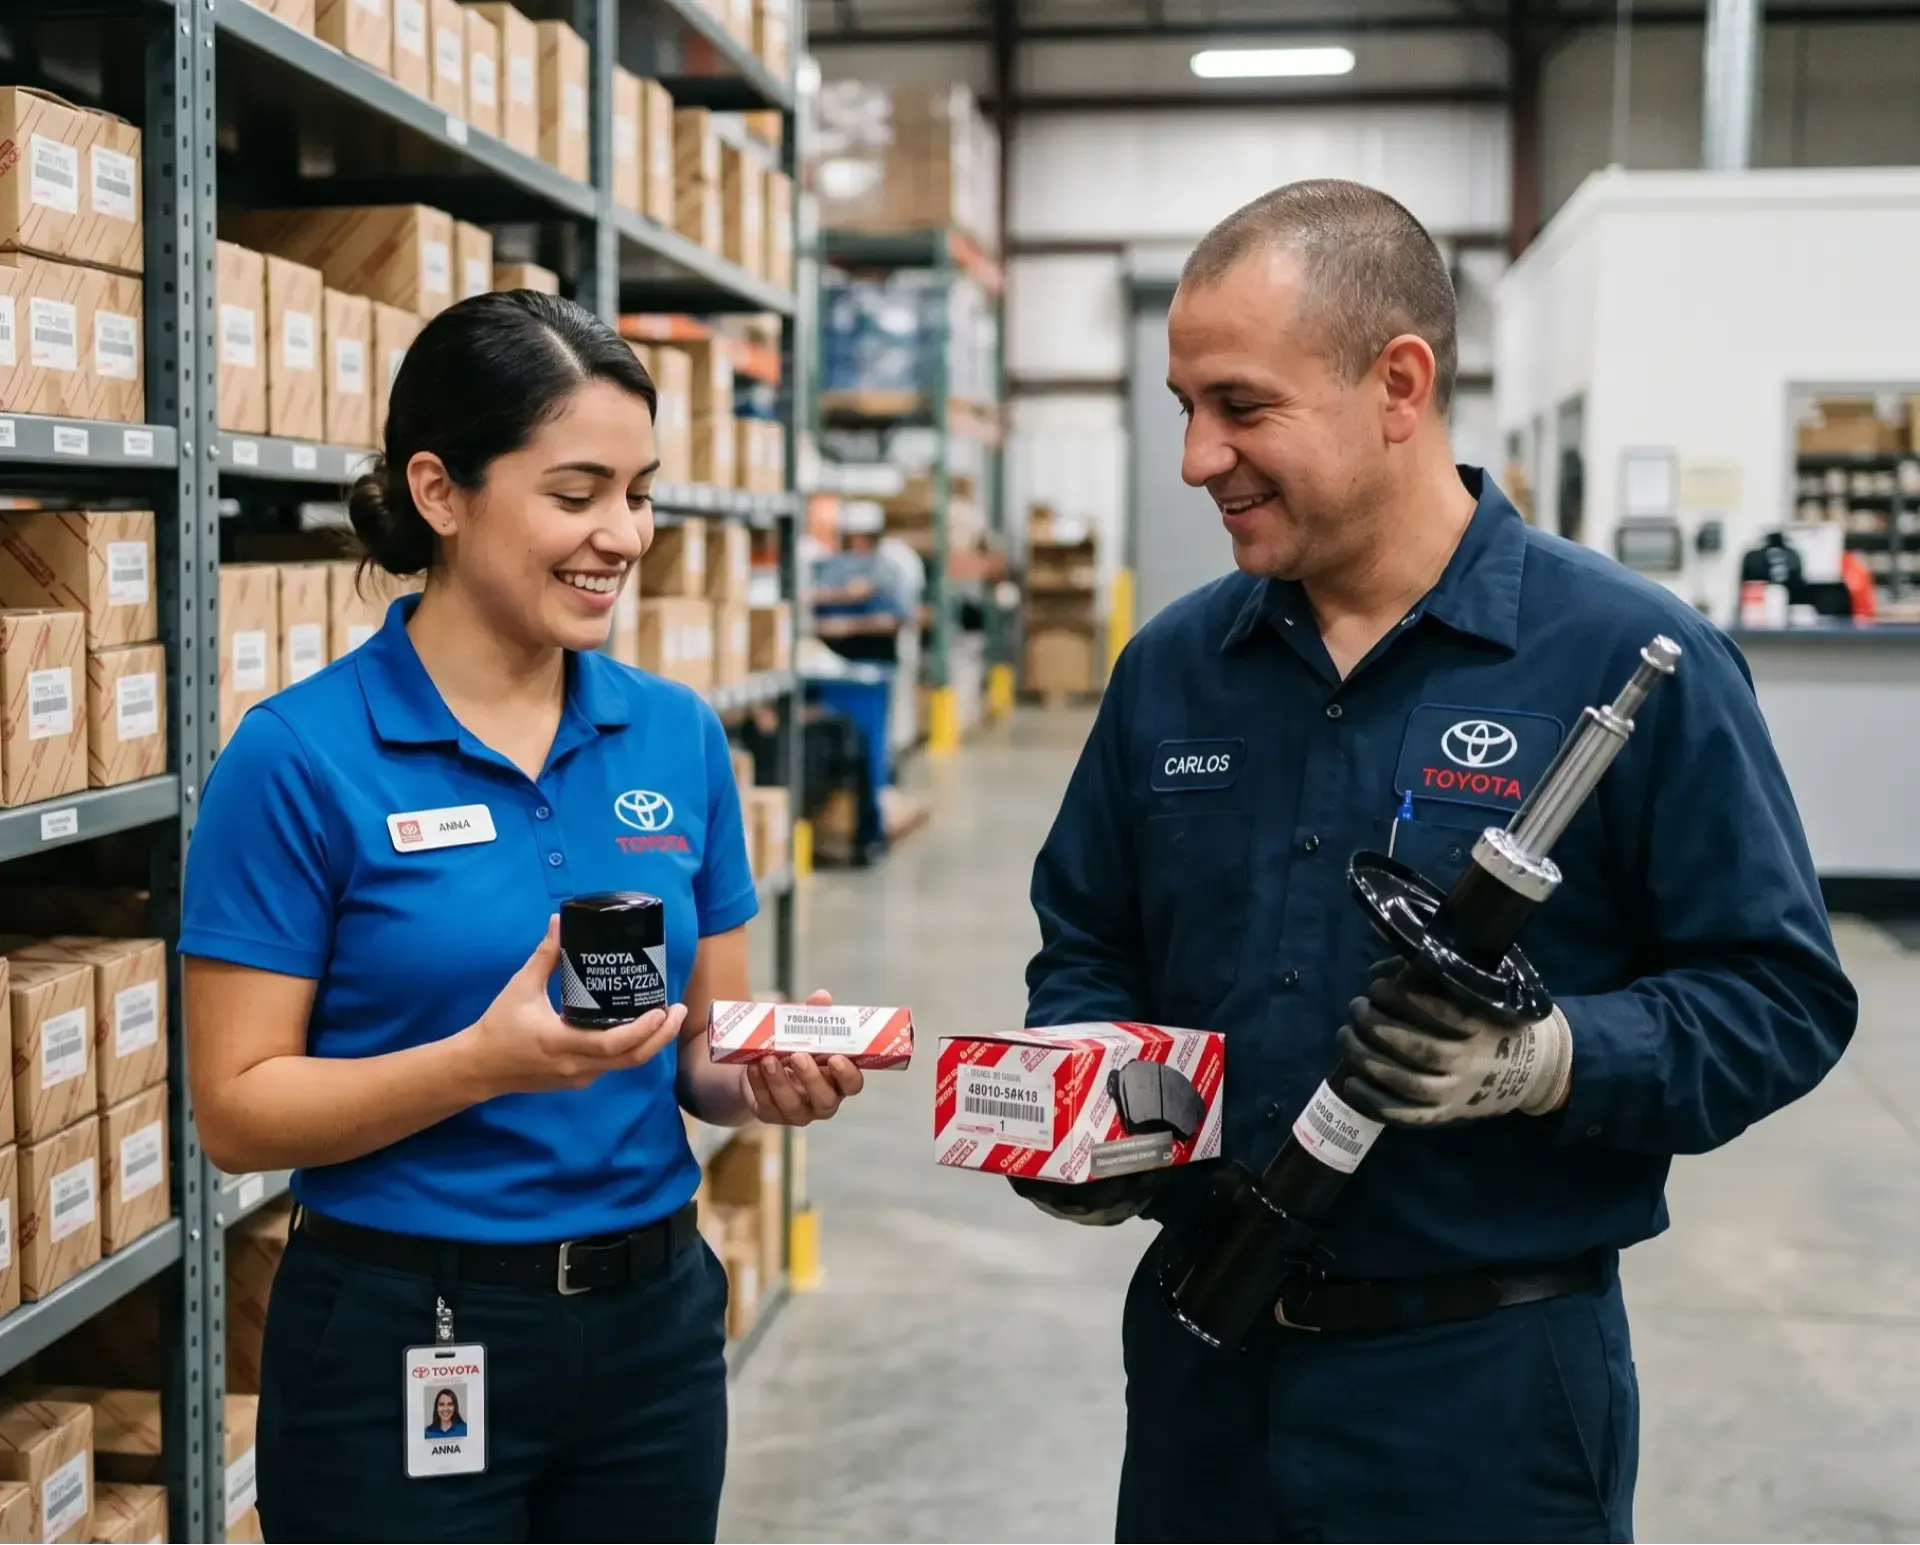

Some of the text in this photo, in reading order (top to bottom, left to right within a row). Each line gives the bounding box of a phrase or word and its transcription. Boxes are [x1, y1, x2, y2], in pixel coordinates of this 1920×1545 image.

[1164, 753, 1231, 776] CARLOS
[1422, 767, 1522, 801] TOYOTA
[439, 819, 471, 833] ANNA
[615, 834, 691, 854] TOYOTA
[580, 952, 635, 965] TOYOTA
[999, 1120, 1005, 1132] 1
[432, 1364, 480, 1377] TOYOTA
[431, 1444, 461, 1455] ANNA
